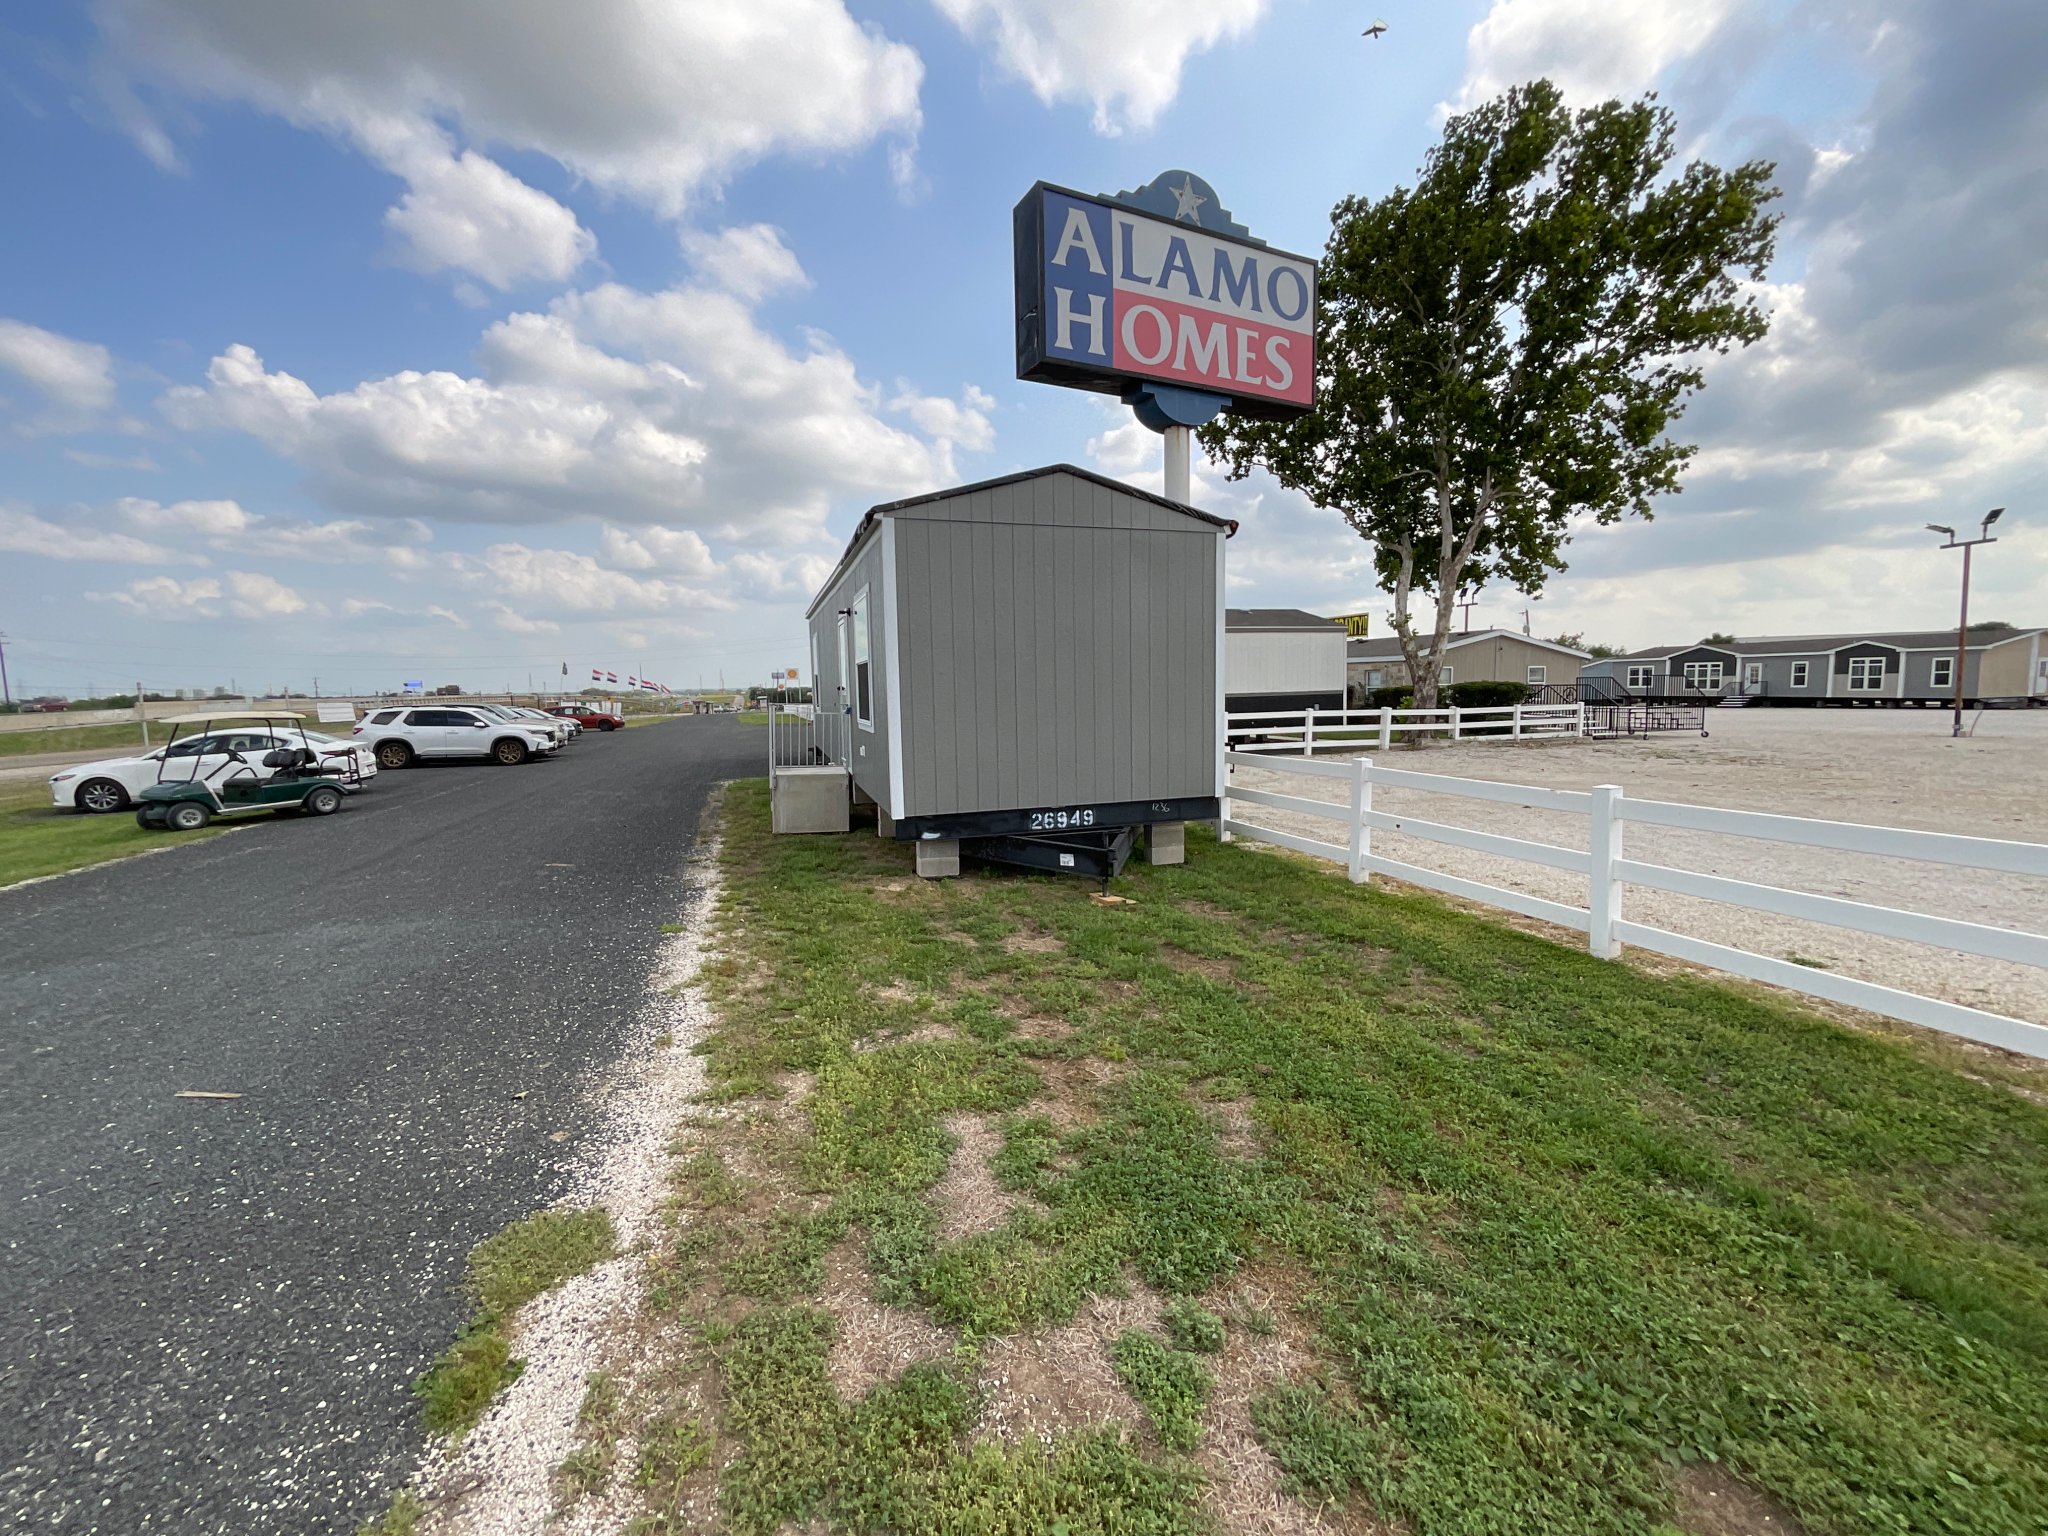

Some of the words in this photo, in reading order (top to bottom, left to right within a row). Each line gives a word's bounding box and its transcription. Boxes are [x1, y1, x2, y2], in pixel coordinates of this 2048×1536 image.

[1051, 207, 1309, 321] ALAMO
[1053, 286, 1293, 391] HOMES
[1031, 809, 1094, 830] 26949
